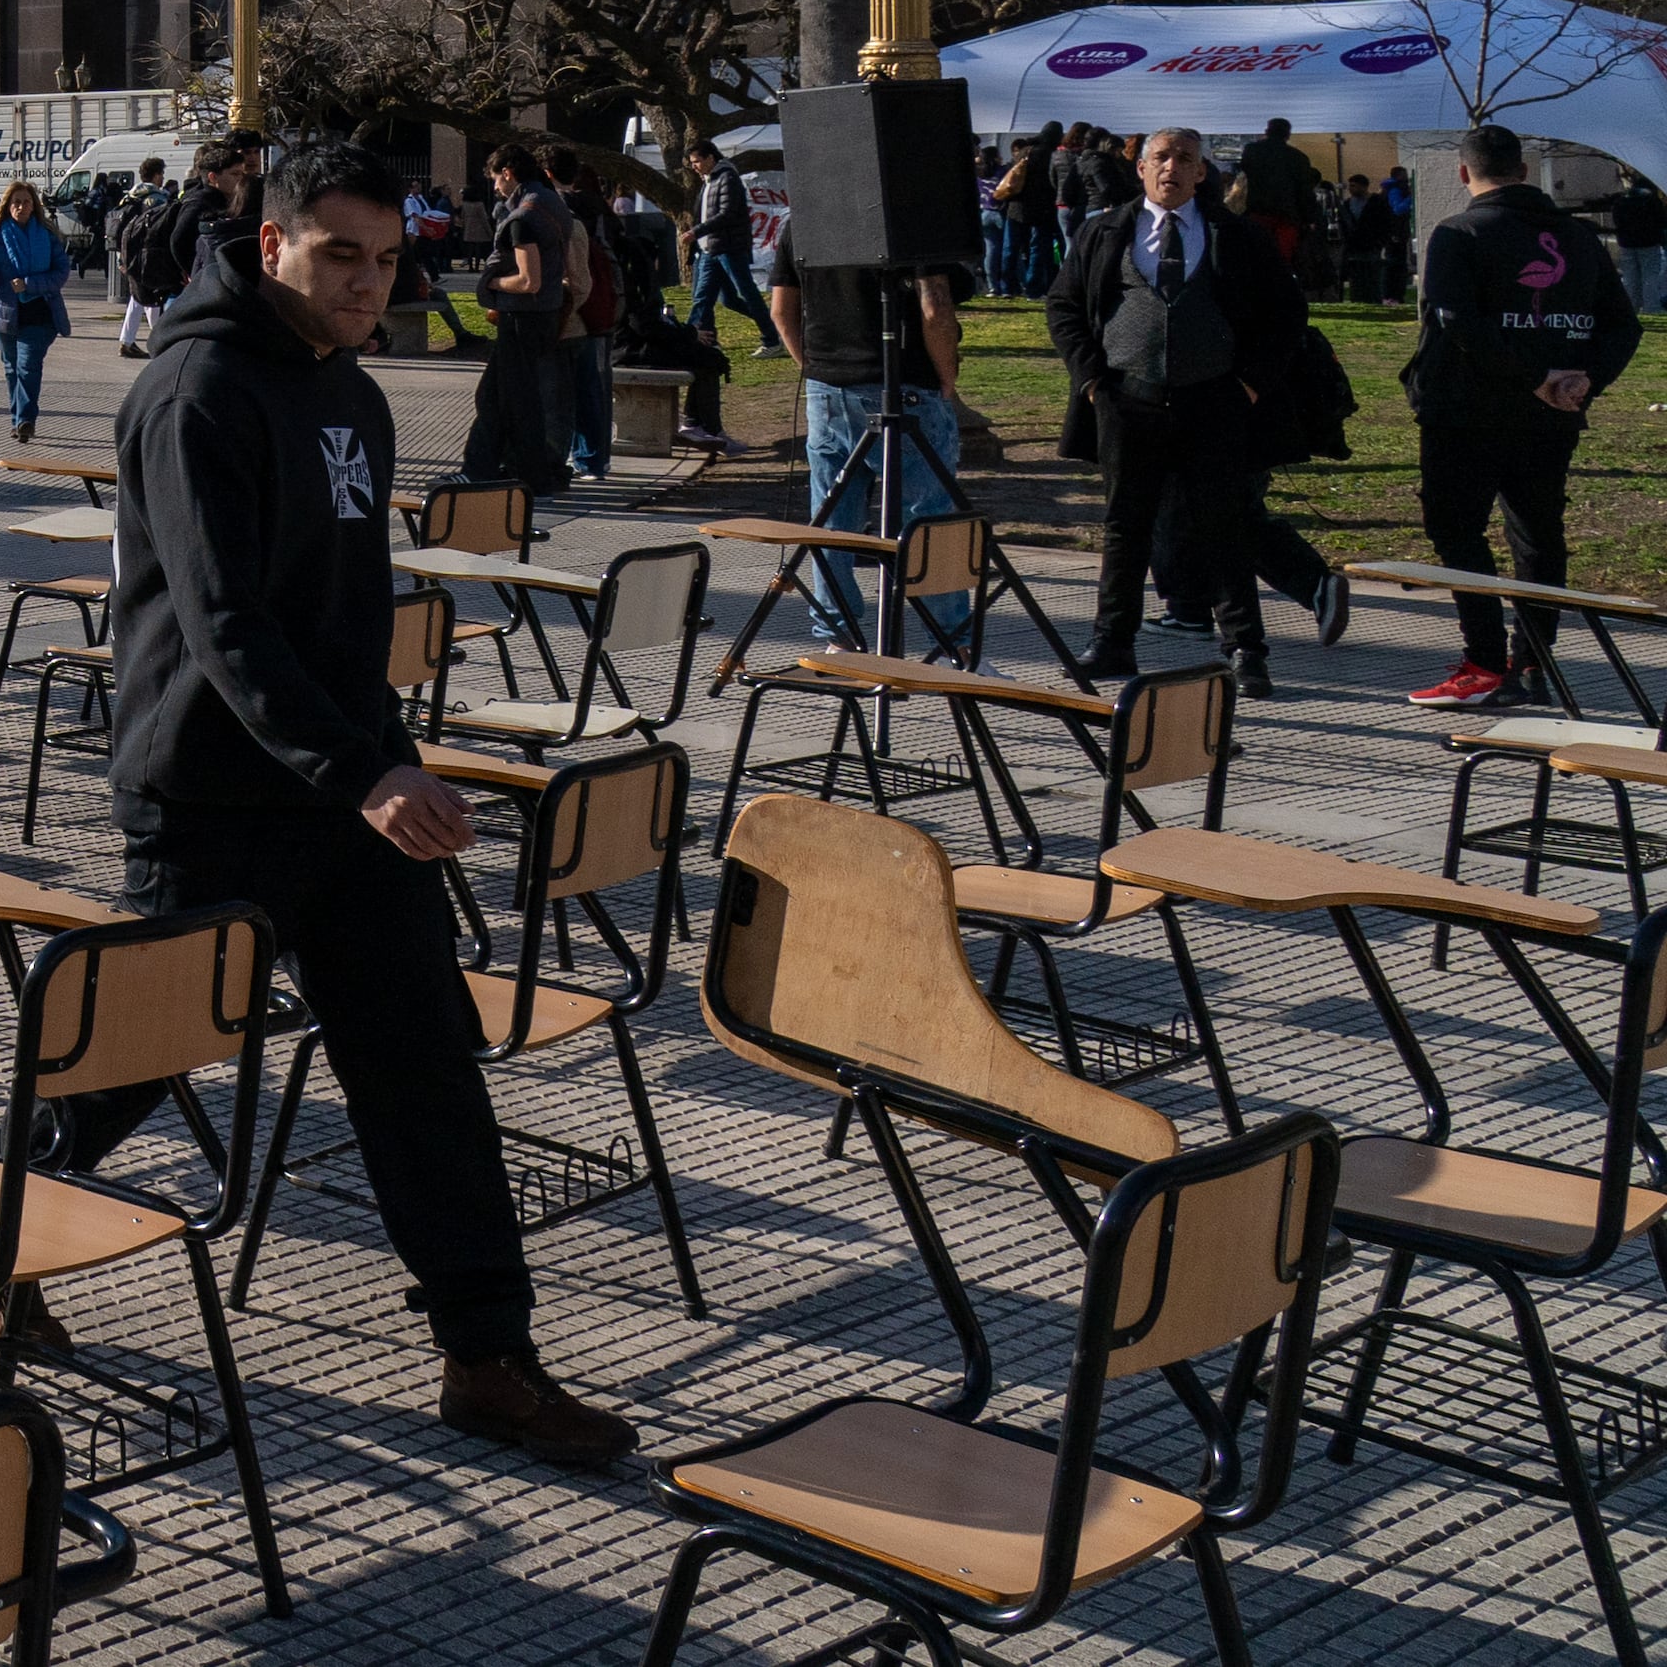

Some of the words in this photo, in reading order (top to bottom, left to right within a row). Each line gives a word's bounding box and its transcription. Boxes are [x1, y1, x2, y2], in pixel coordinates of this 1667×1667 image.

[1191, 46, 1260, 55] UBA
[1272, 43, 1324, 53] EN
[333, 430, 343, 457] WEST
[338, 487, 347, 516] COAST
